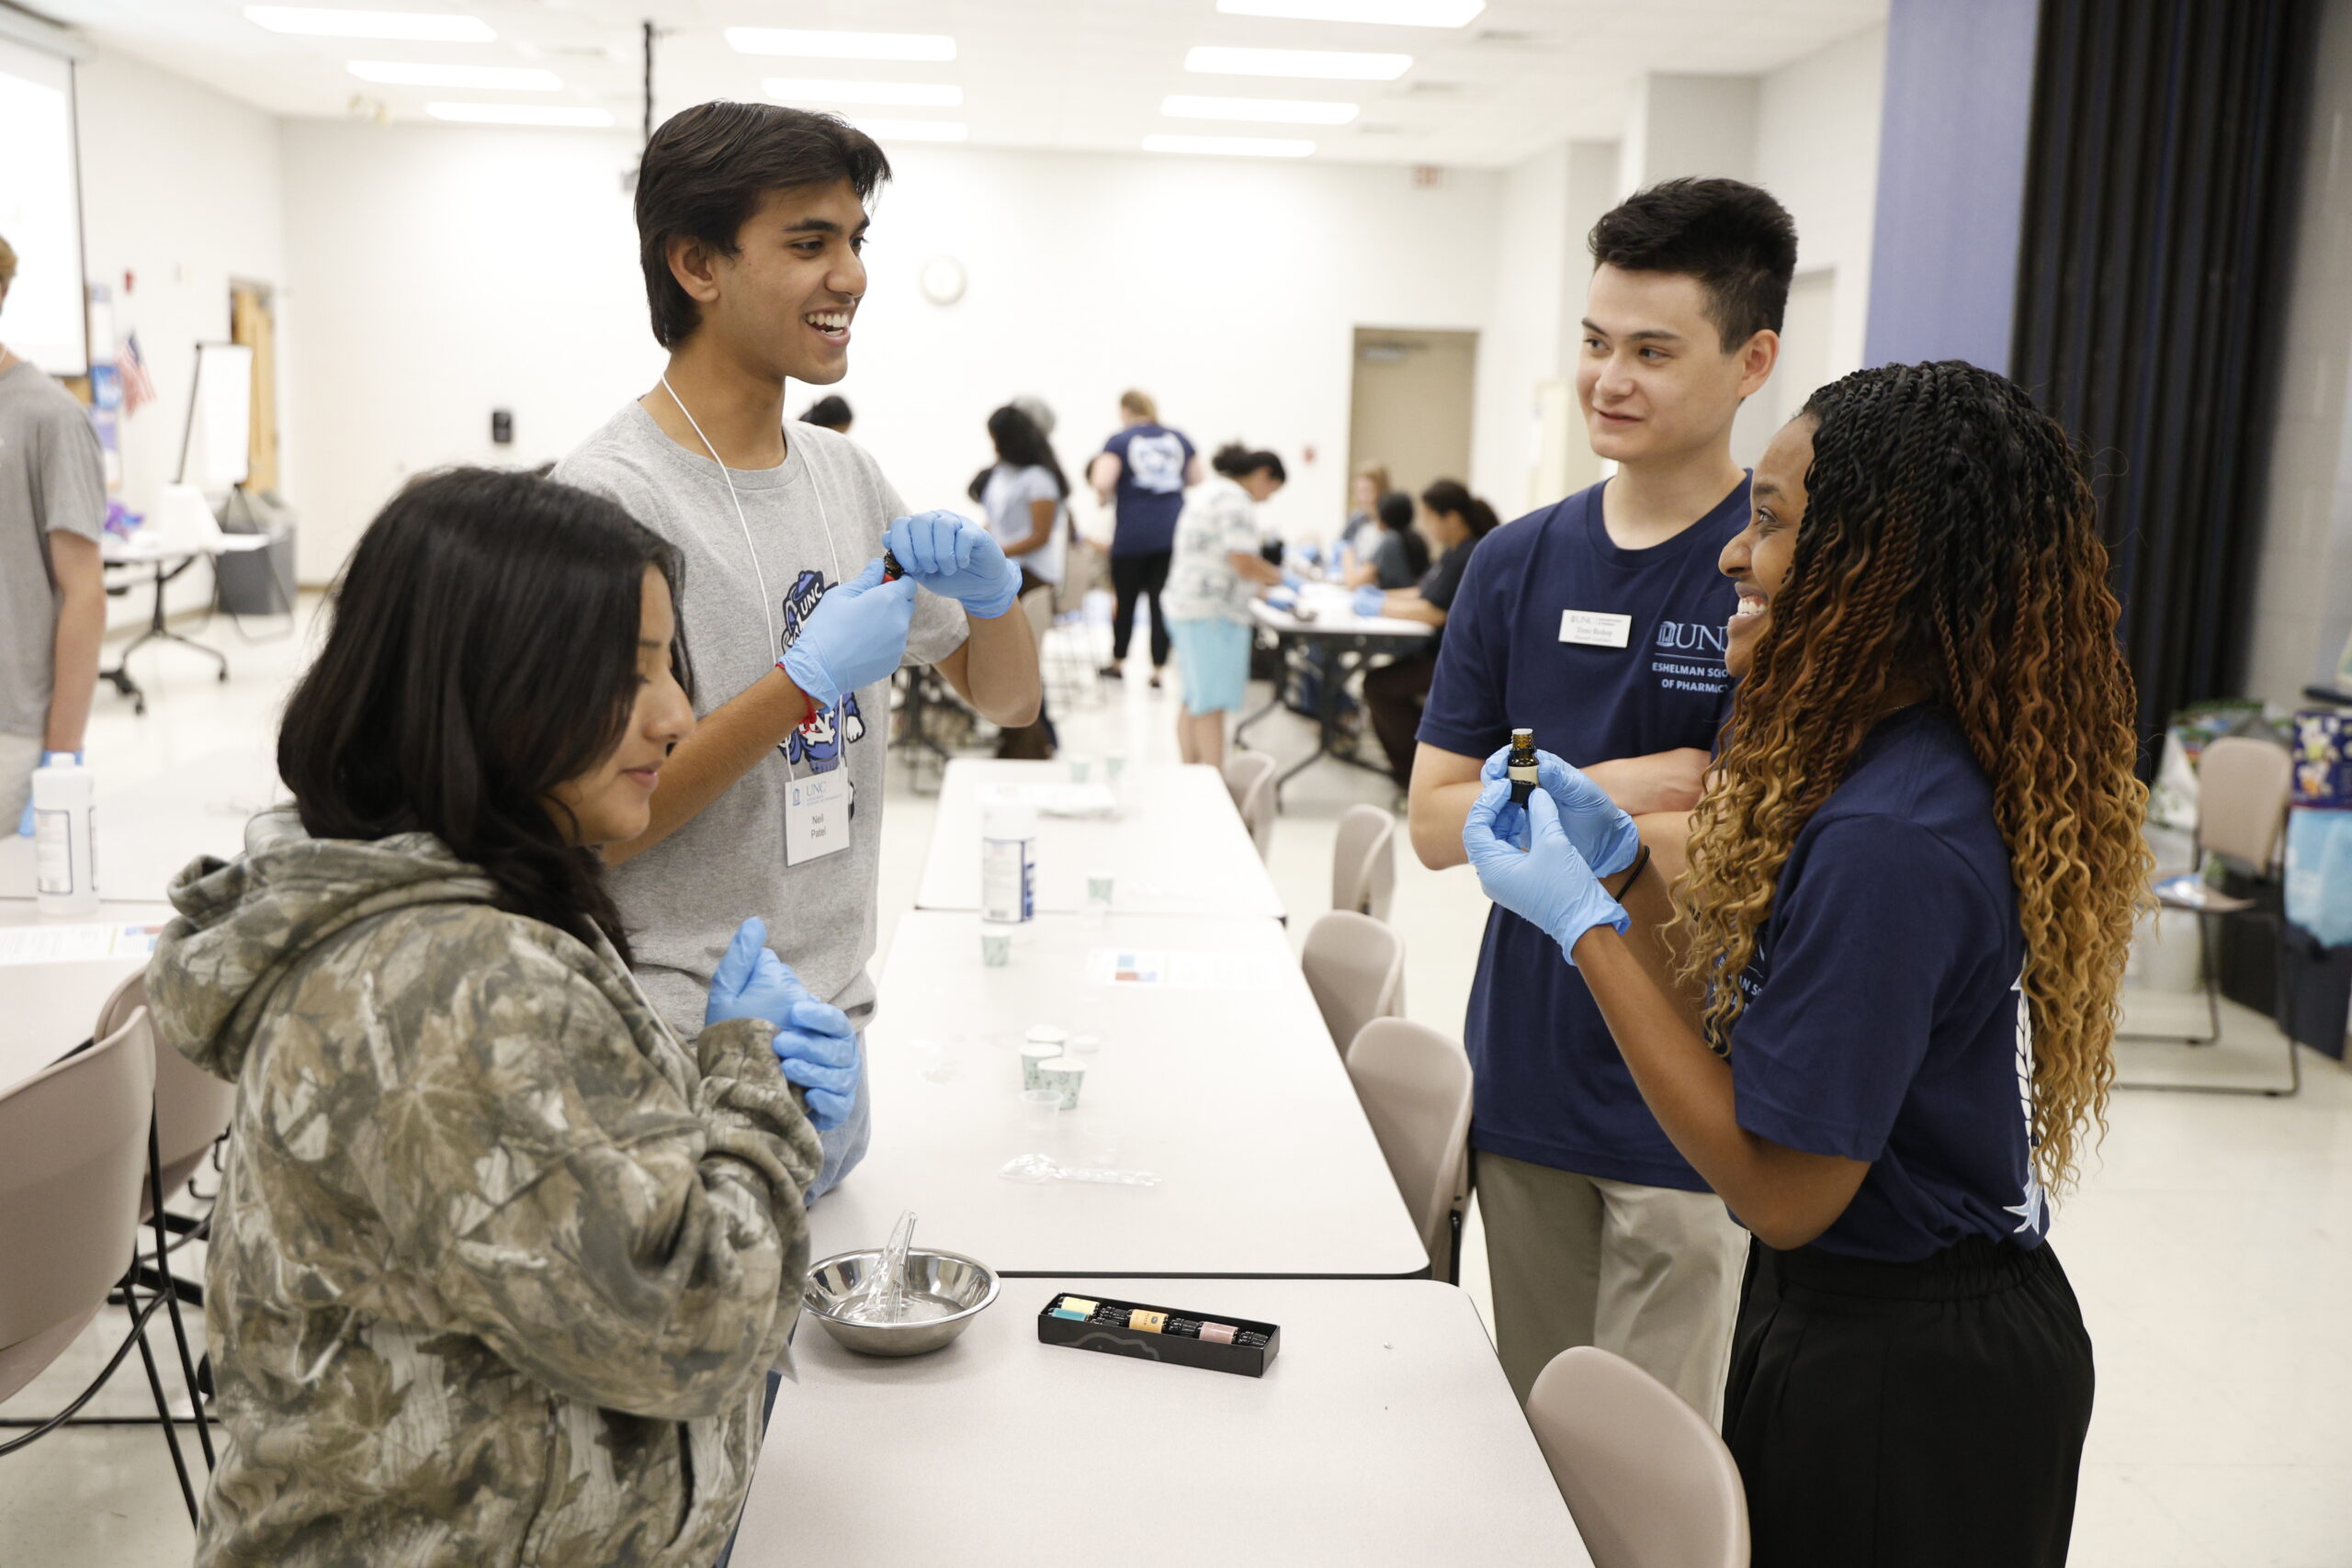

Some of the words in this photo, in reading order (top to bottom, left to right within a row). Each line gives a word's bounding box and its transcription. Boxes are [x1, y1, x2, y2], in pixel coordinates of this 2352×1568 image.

[799, 581, 823, 616] UNC
[1676, 623, 1728, 651] UN
[1651, 661, 1705, 676] ESHELMAN
[1661, 679, 1675, 689] OF
[1676, 680, 1728, 694] PHARMC
[806, 780, 827, 797] UNC
[811, 813, 824, 825] Neil
[810, 826, 827, 840] Patel
